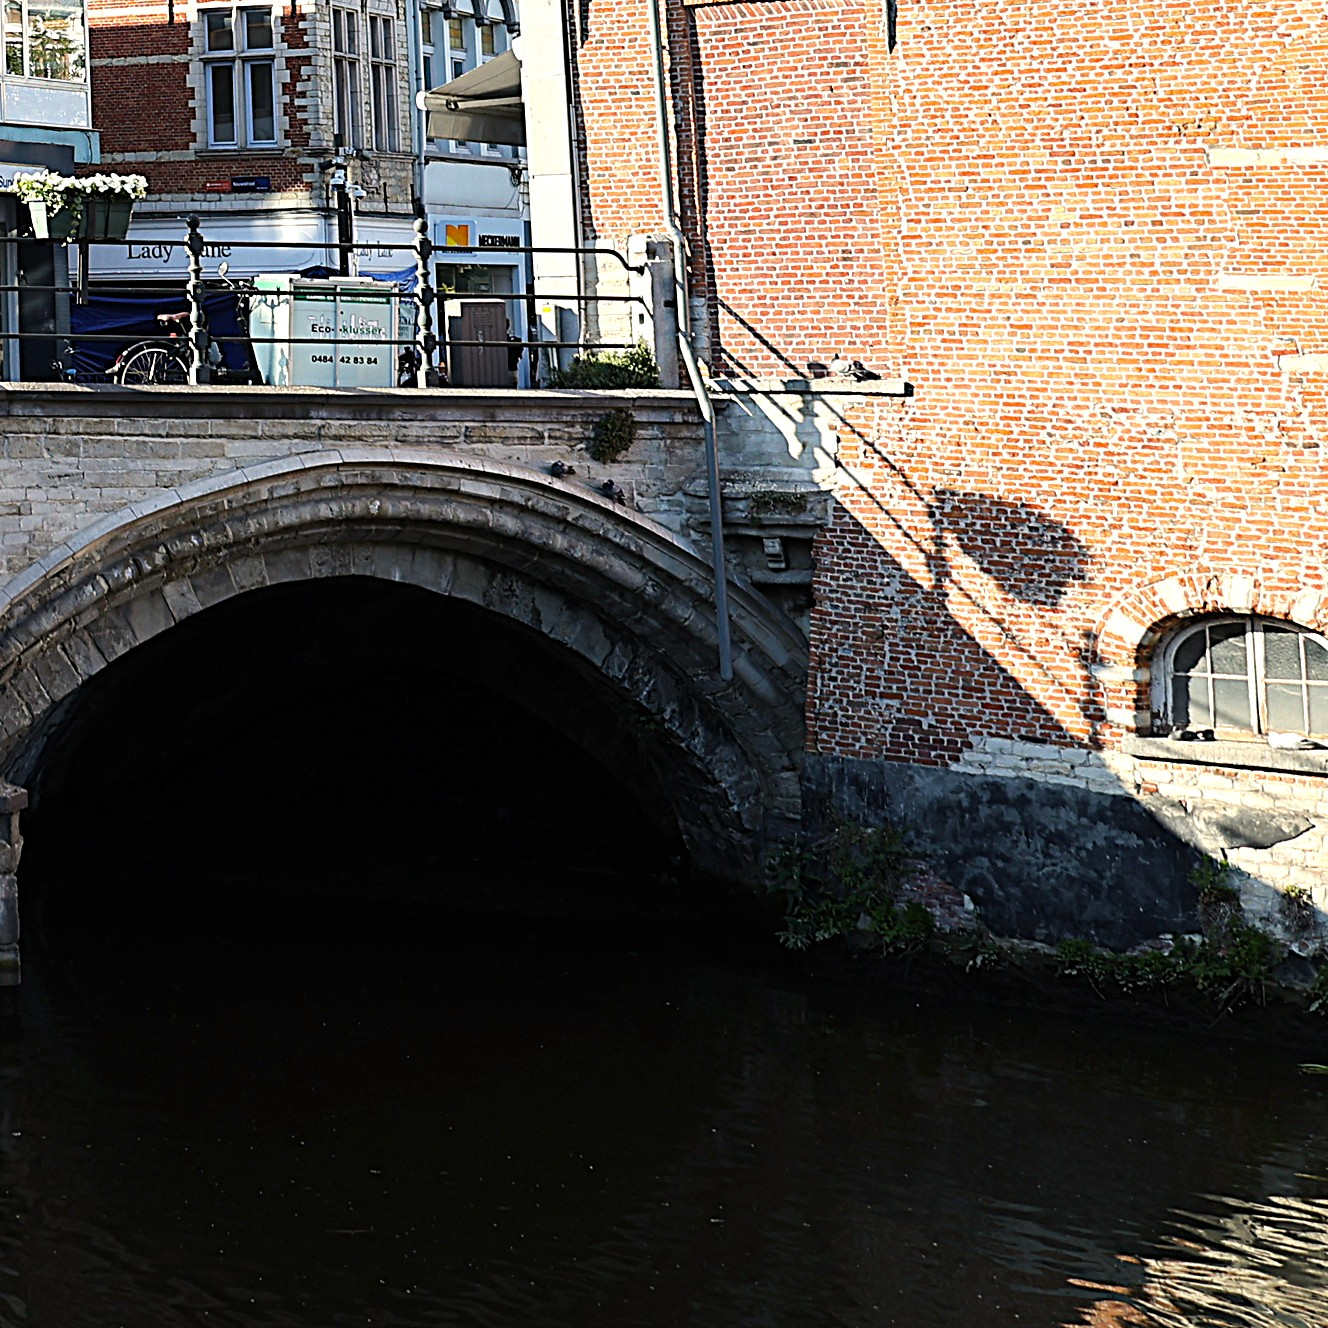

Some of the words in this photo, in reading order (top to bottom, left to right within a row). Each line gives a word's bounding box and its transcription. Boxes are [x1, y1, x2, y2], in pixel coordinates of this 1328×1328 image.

[127, 242, 173, 263] Lady
[311, 355, 334, 364] 0484
[339, 356, 351, 364] 42
[353, 356, 364, 365] 83
[367, 357, 378, 365] 84
